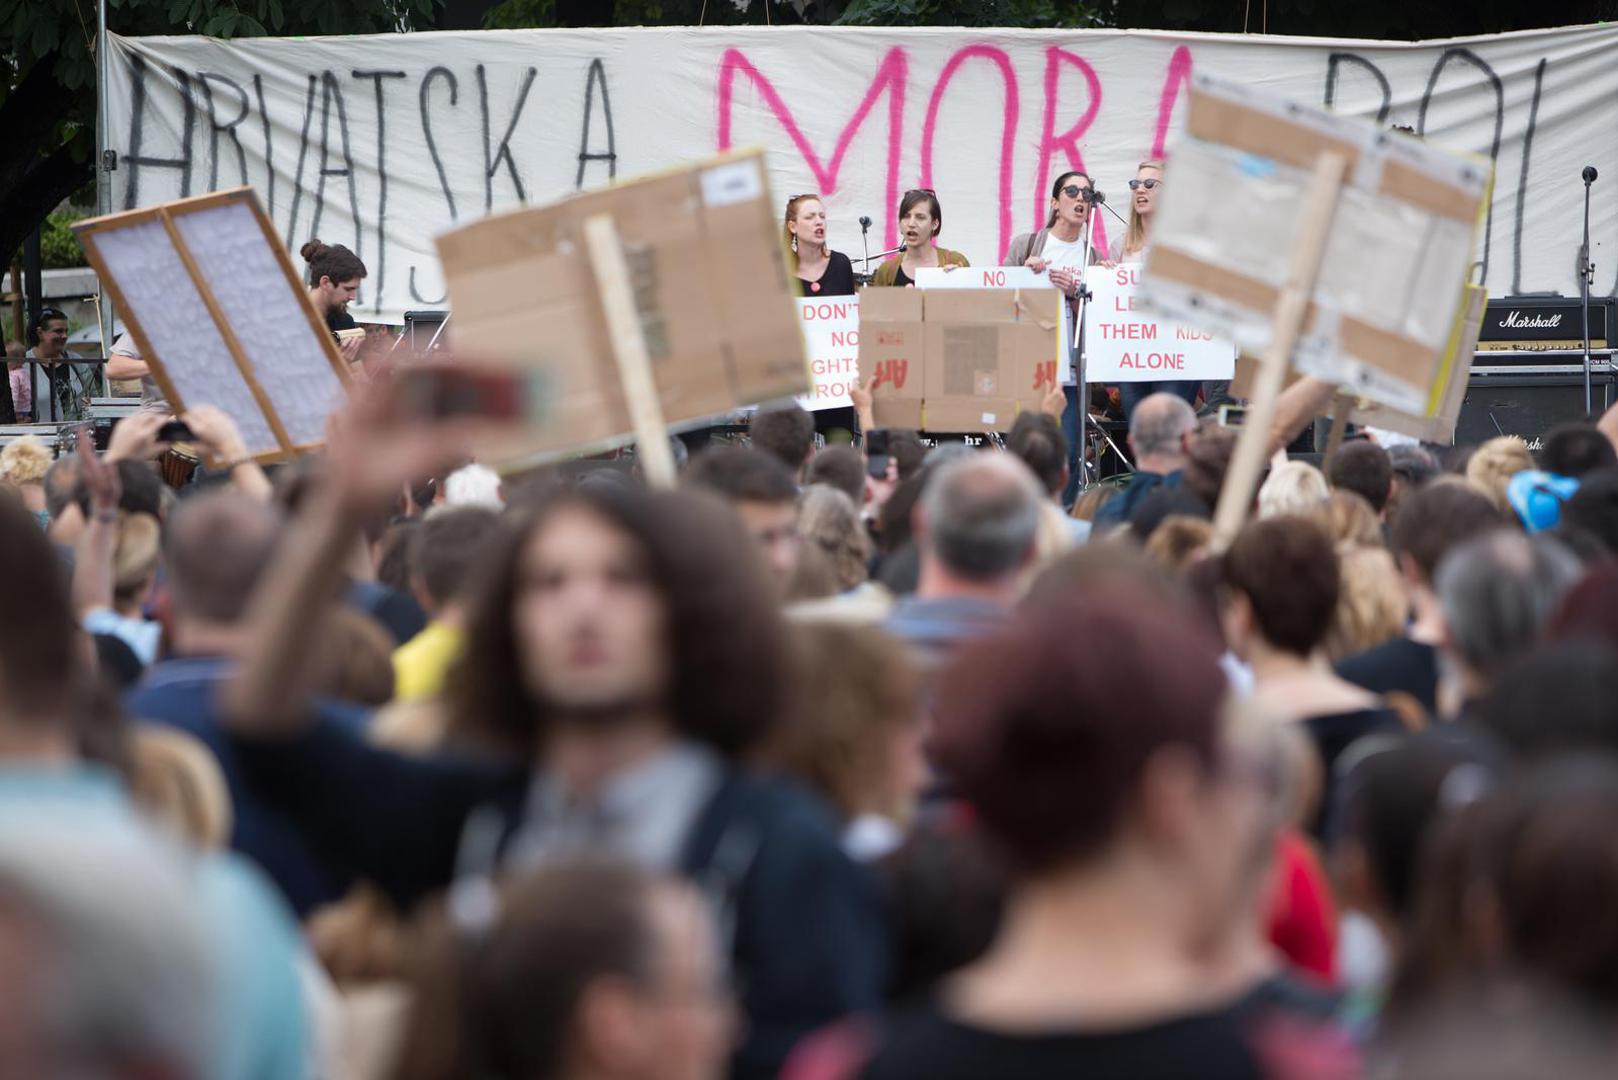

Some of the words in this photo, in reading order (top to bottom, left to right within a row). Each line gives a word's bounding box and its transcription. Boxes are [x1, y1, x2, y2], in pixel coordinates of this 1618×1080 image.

[983, 270, 1006, 287] NO
[1499, 310, 1562, 328] Marshall
[831, 331, 860, 347] NO
[1099, 323, 1158, 340] THEM
[811, 358, 858, 375] GHT
[1118, 352, 1185, 370] ALONE
